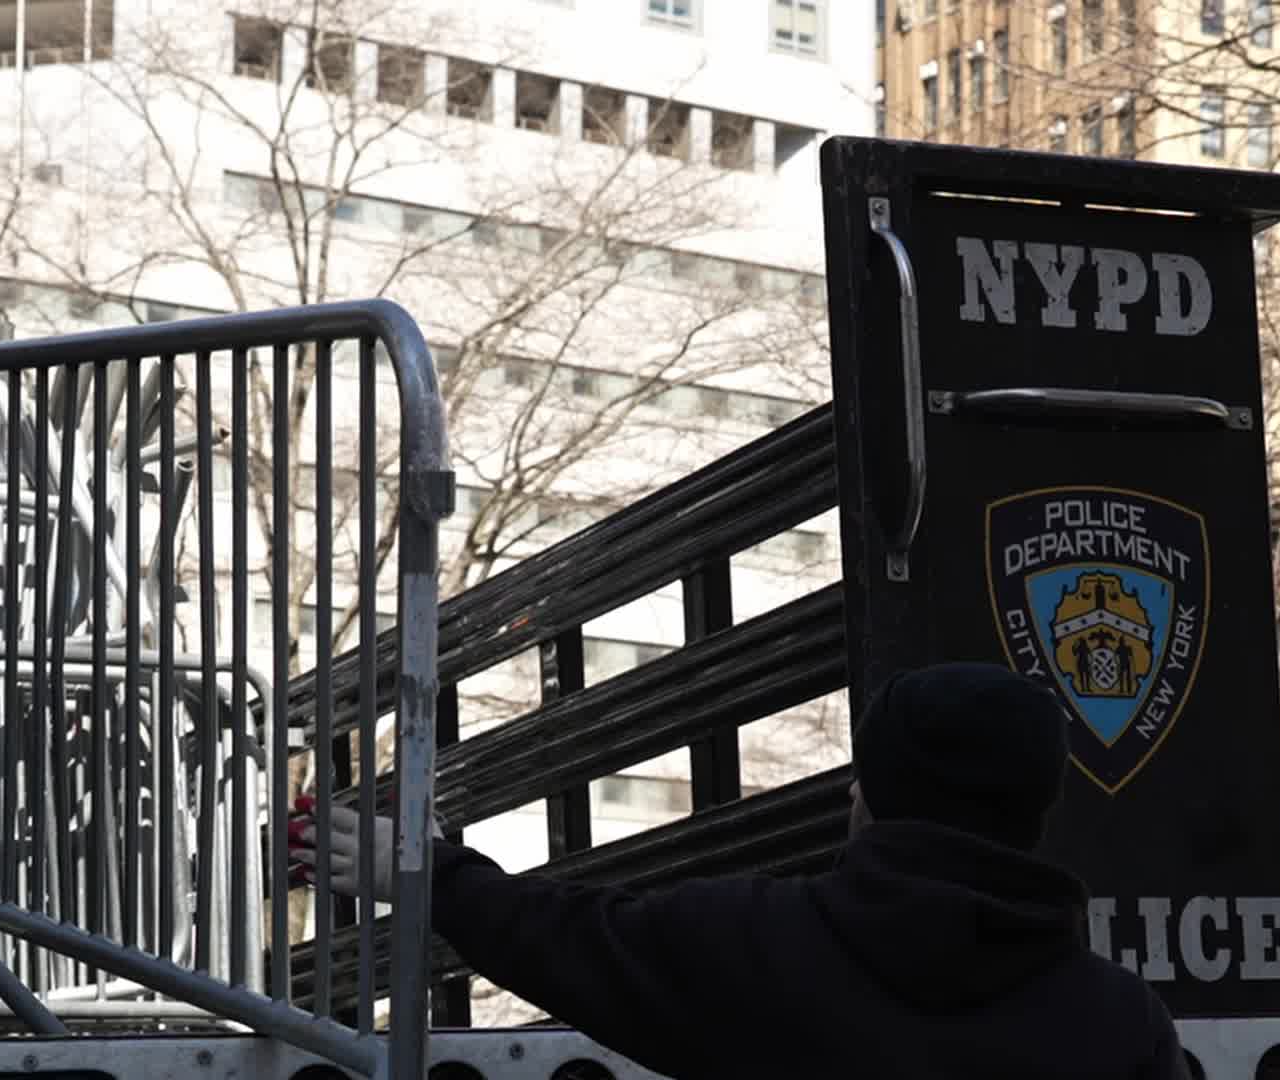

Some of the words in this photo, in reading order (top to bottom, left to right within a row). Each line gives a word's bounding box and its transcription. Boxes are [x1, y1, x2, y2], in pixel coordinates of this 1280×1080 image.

[956, 236, 1213, 336] NYPD
[1045, 500, 1147, 533] POLICE
[1004, 529, 1190, 581] DEPARTMENT
[1006, 608, 1046, 679] CITY
[1136, 679, 1176, 740] NEW
[1167, 604, 1196, 671] YORK
